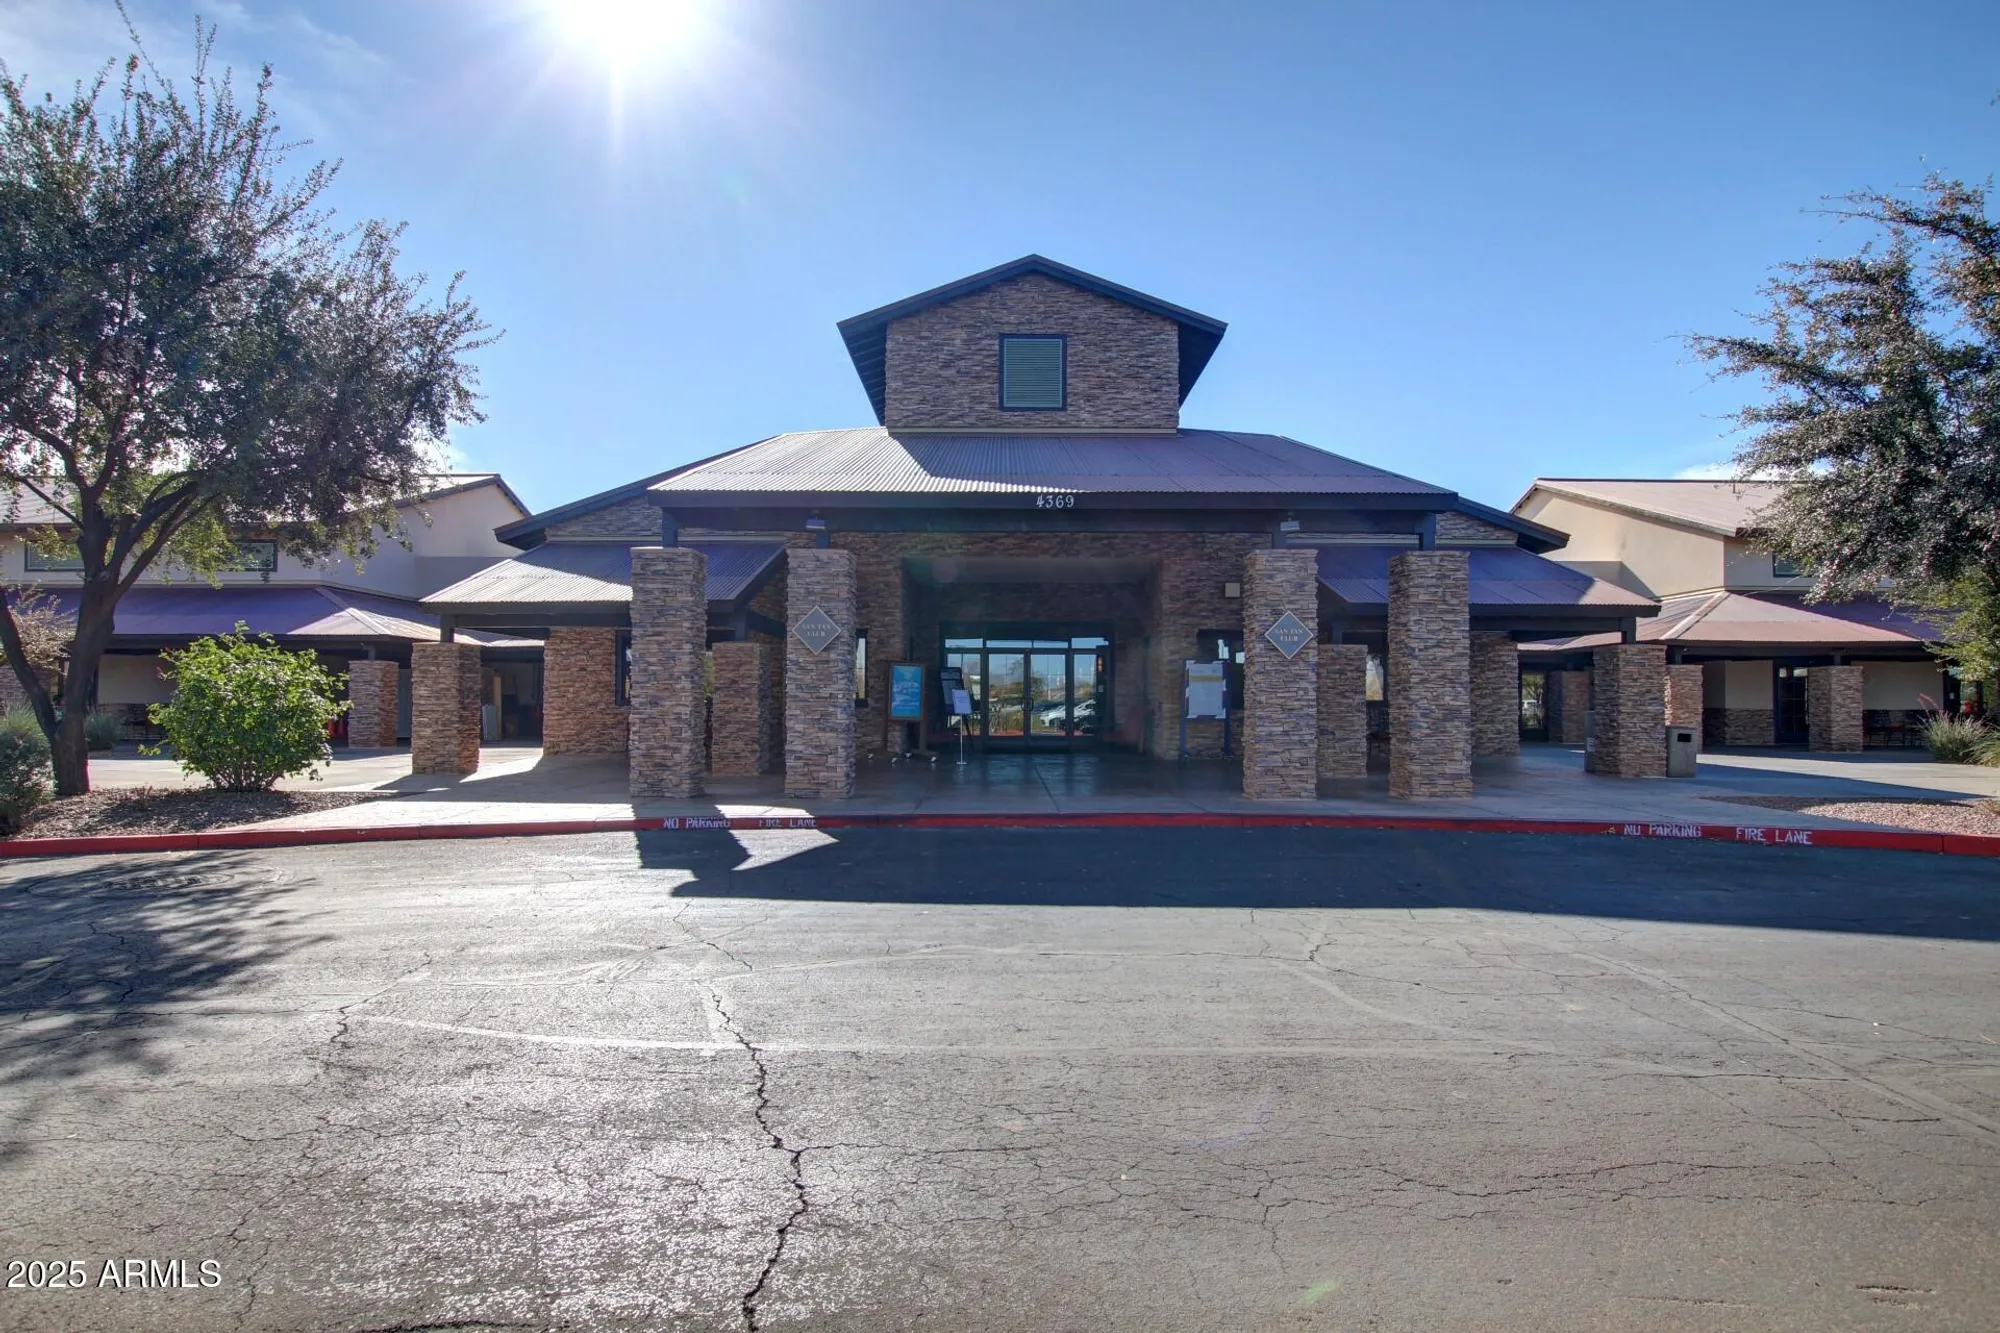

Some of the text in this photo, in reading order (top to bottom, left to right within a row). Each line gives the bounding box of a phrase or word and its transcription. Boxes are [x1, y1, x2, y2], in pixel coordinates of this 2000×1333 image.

[1036, 494, 1074, 508] 4369
[663, 817, 679, 829] NO
[685, 817, 731, 829] PARKING
[1650, 824, 1702, 838] PARKING
[1735, 827, 1766, 842] FIRE
[1774, 830, 1813, 845] LANE
